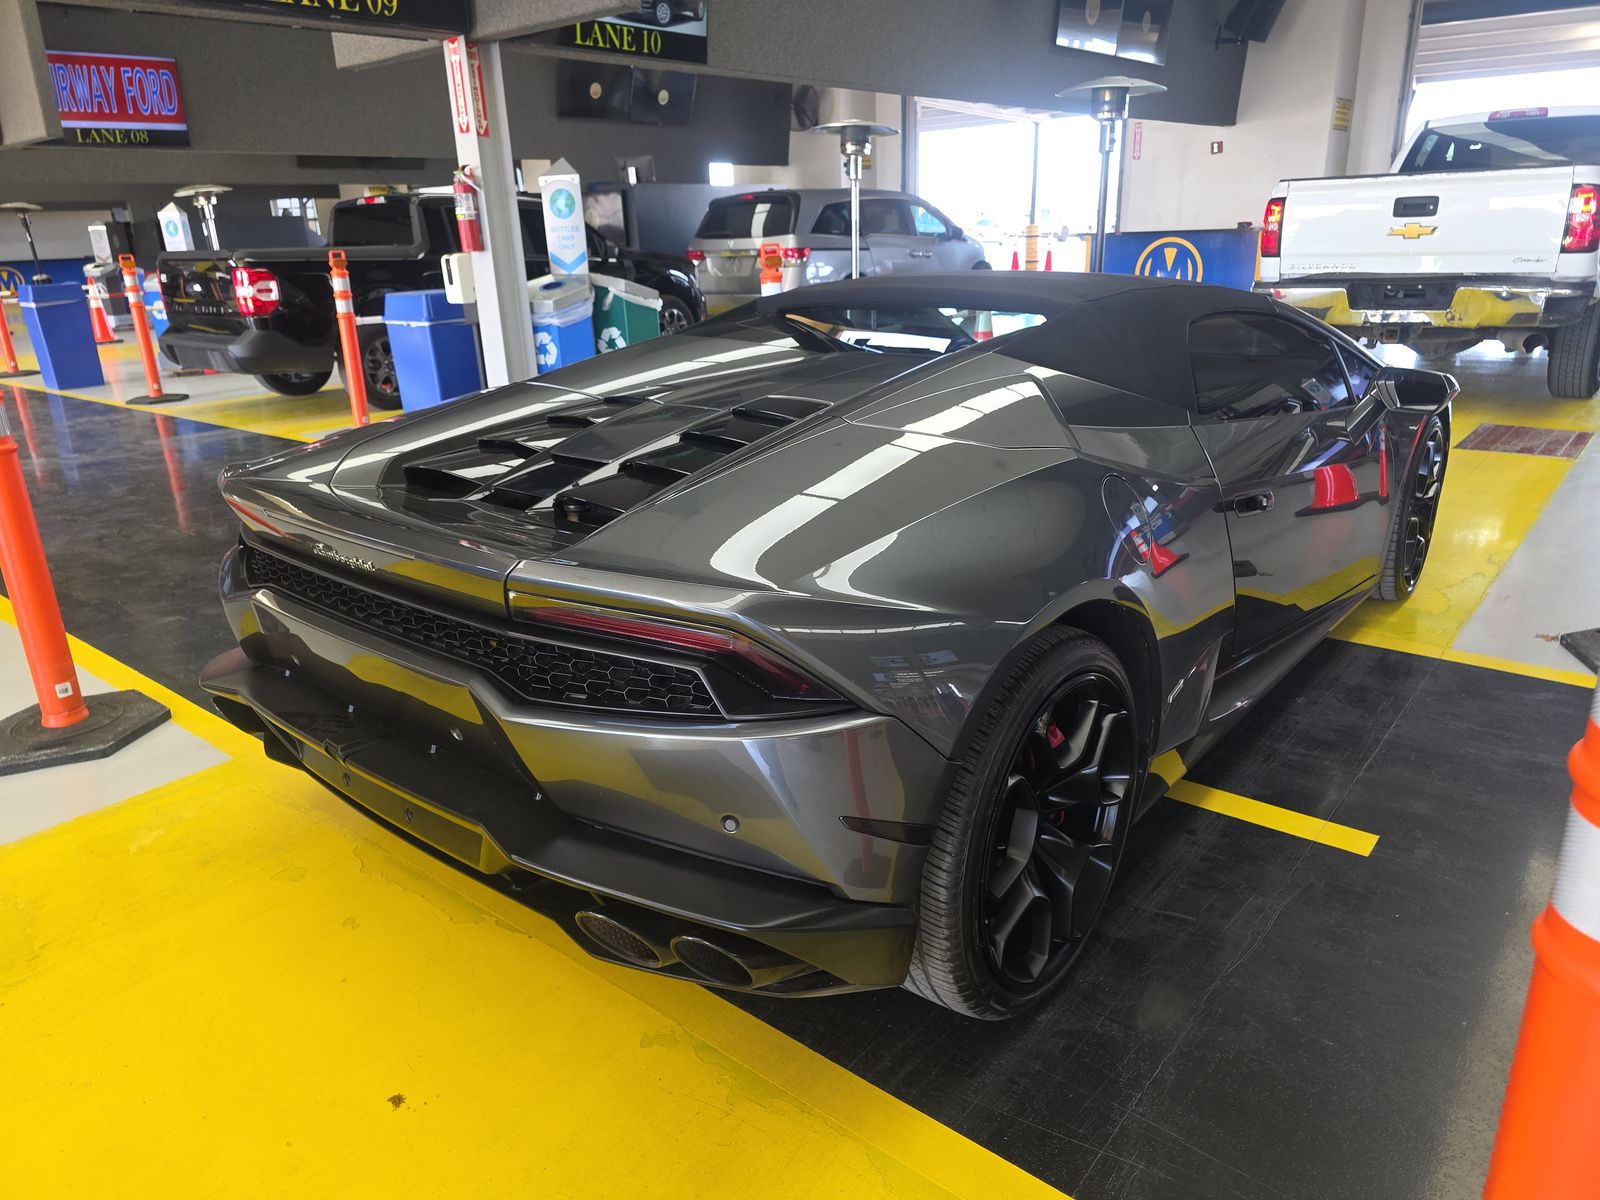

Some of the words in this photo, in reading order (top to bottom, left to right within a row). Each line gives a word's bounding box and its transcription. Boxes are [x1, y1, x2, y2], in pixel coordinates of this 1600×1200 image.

[574, 21, 636, 51] LANE
[642, 30, 661, 54] 10
[121, 66, 178, 116] FORD
[75, 128, 127, 144] LANE
[130, 130, 149, 144] 08
